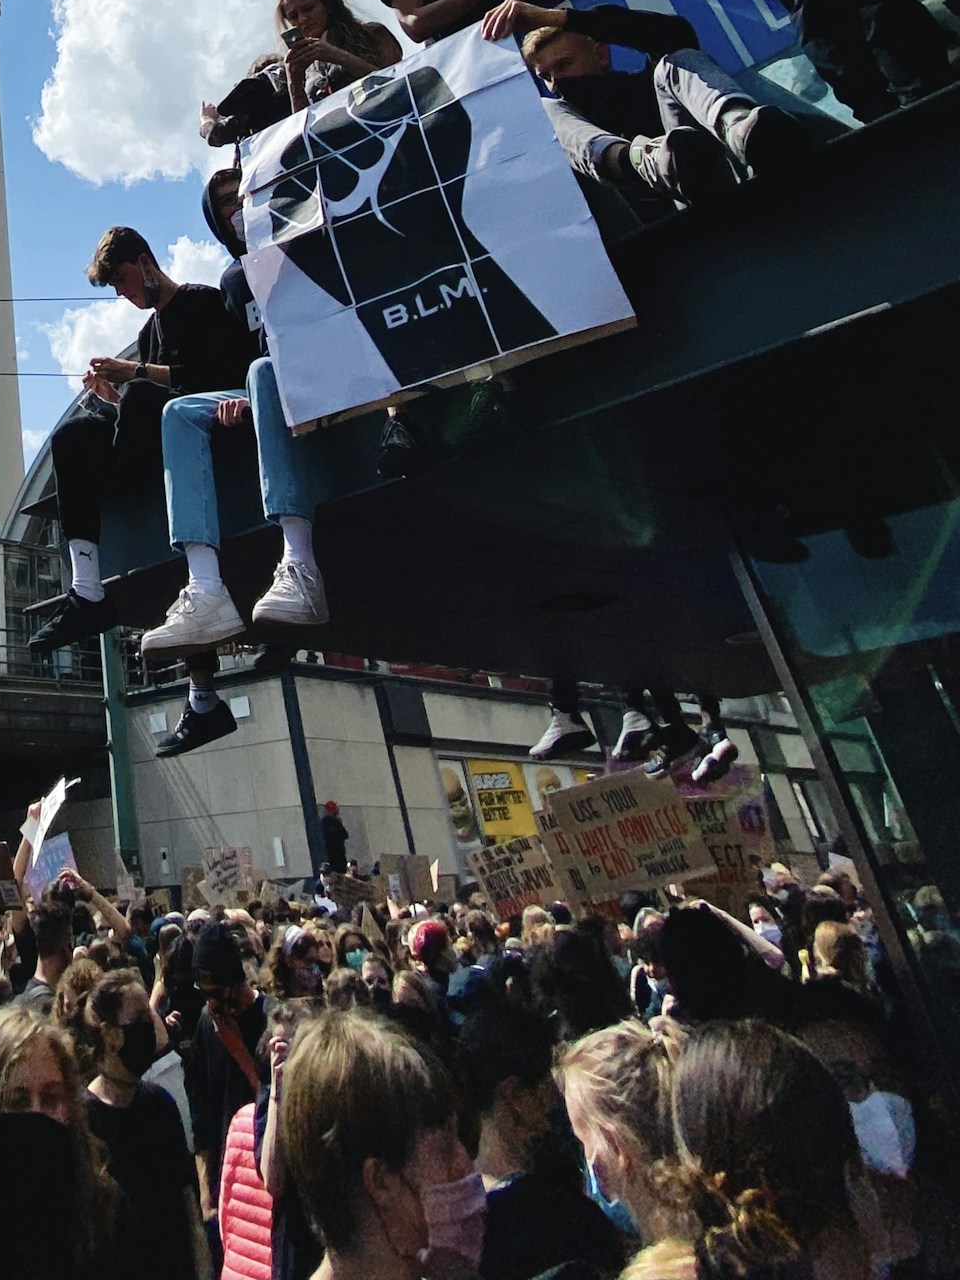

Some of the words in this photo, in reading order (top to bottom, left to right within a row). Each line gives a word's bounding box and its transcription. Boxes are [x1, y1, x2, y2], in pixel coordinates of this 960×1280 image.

[382, 277, 488, 329] B.L.M.
[569, 796, 601, 823] USE
[600, 785, 638, 814] YOUR
[573, 824, 617, 858] WHITE
[598, 846, 635, 880] END
